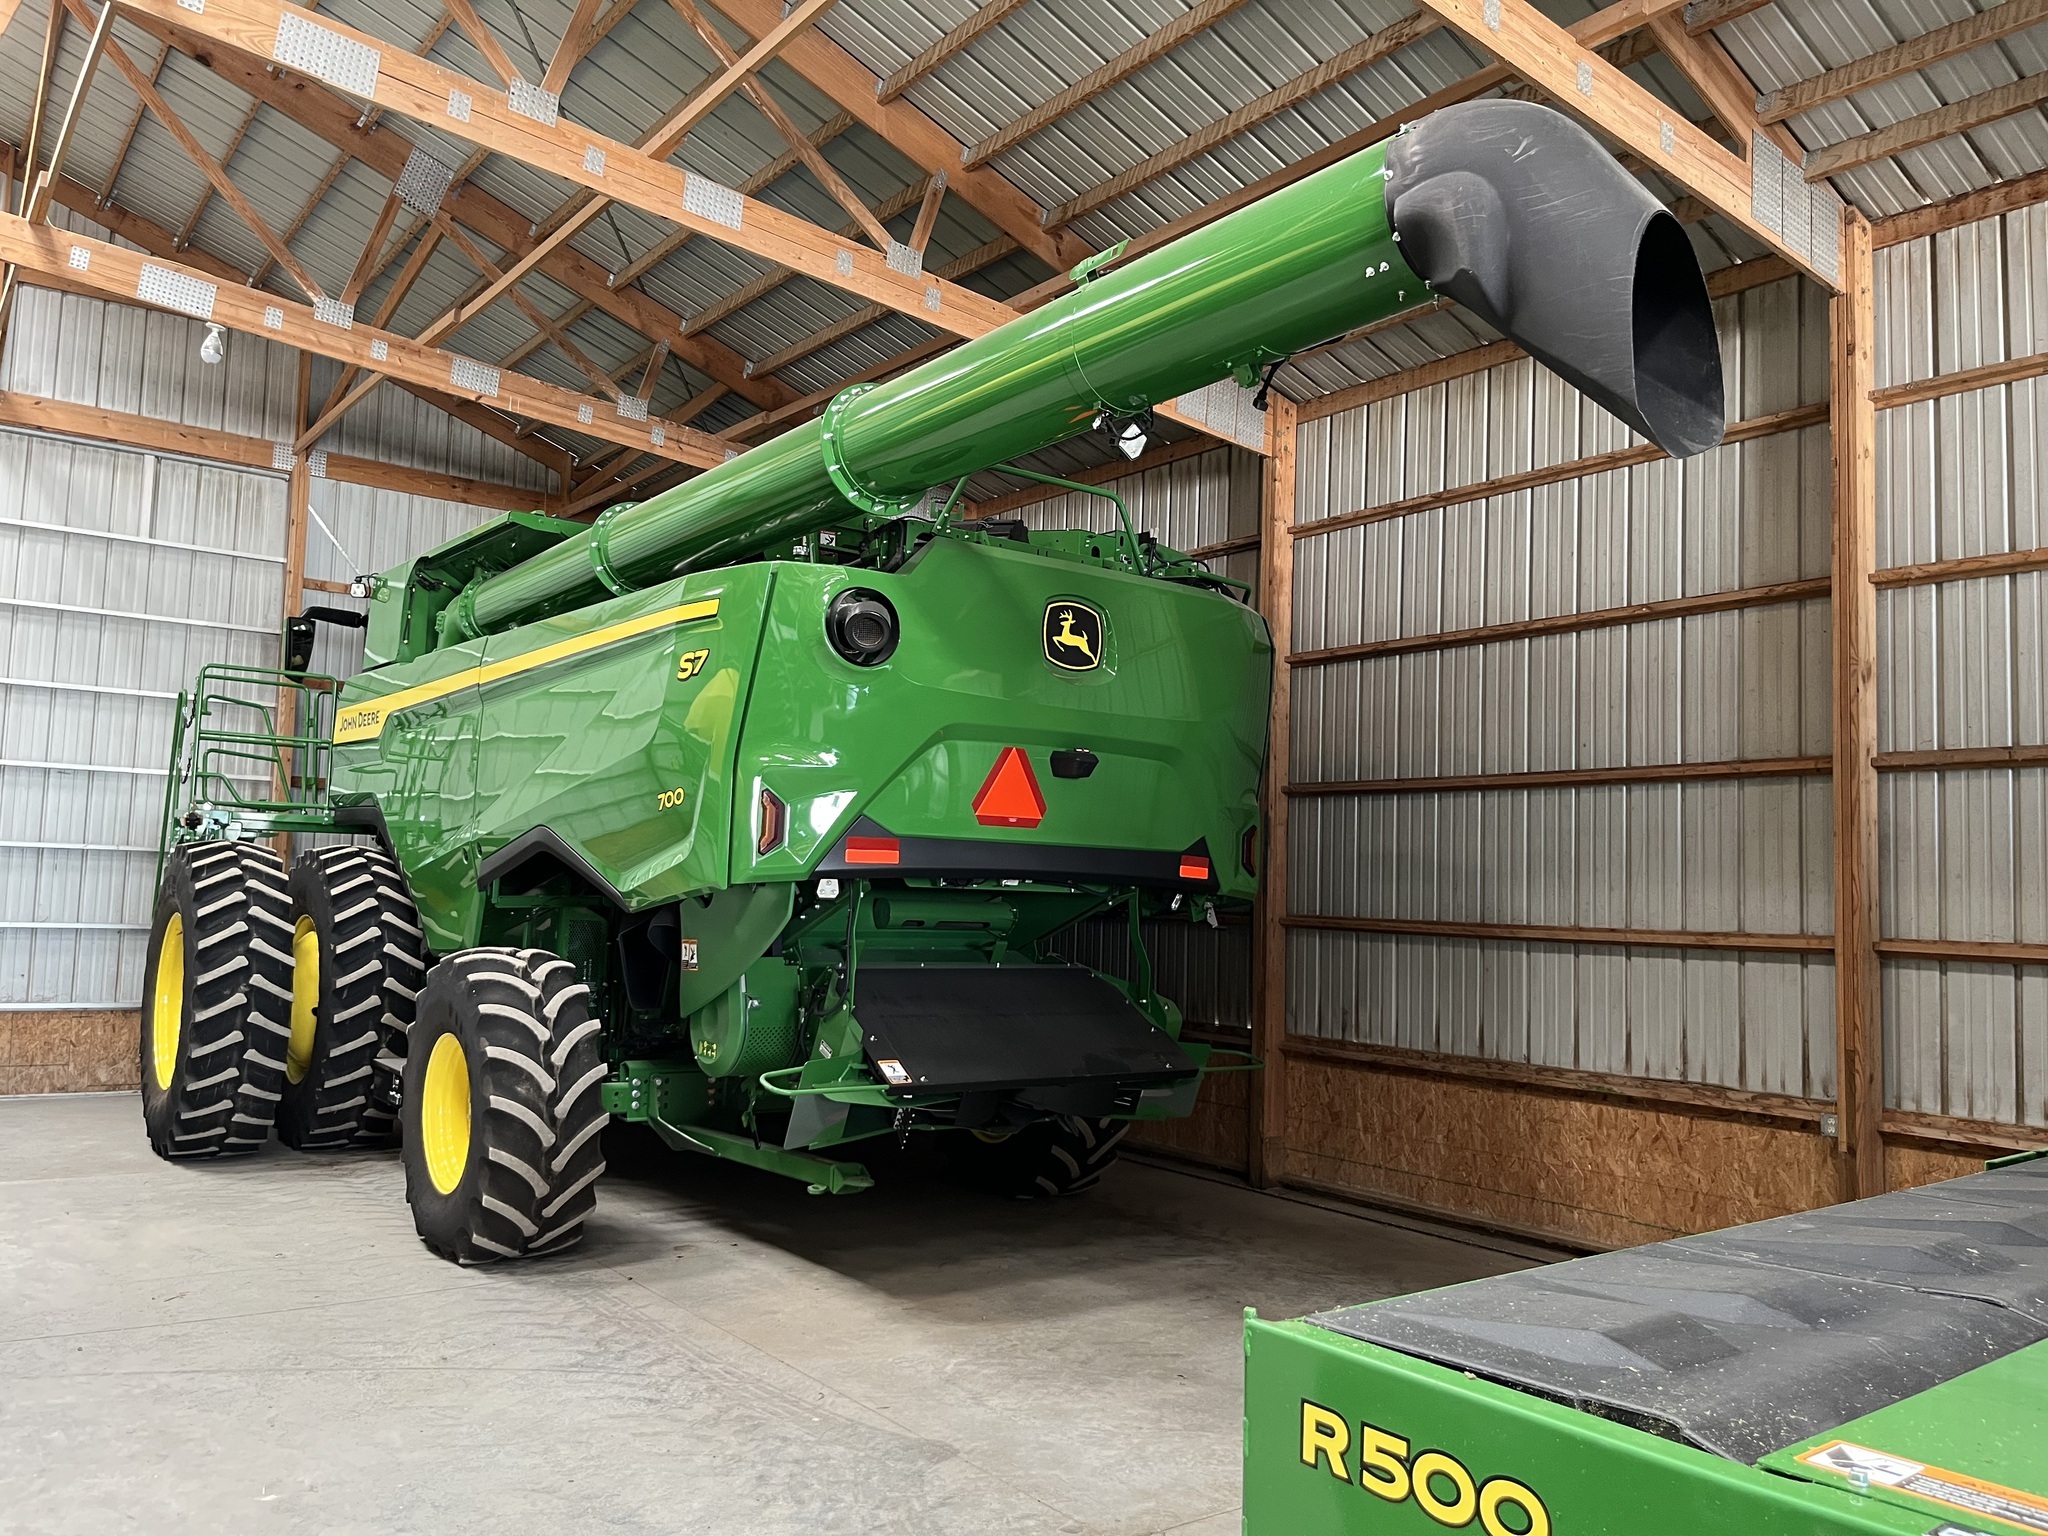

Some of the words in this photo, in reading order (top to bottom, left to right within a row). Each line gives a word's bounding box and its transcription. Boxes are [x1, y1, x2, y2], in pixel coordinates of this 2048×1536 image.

[677, 648, 710, 682] S7
[339, 715, 357, 732] JOHN
[358, 710, 380, 728] DEERE
[657, 786, 685, 812] 700
